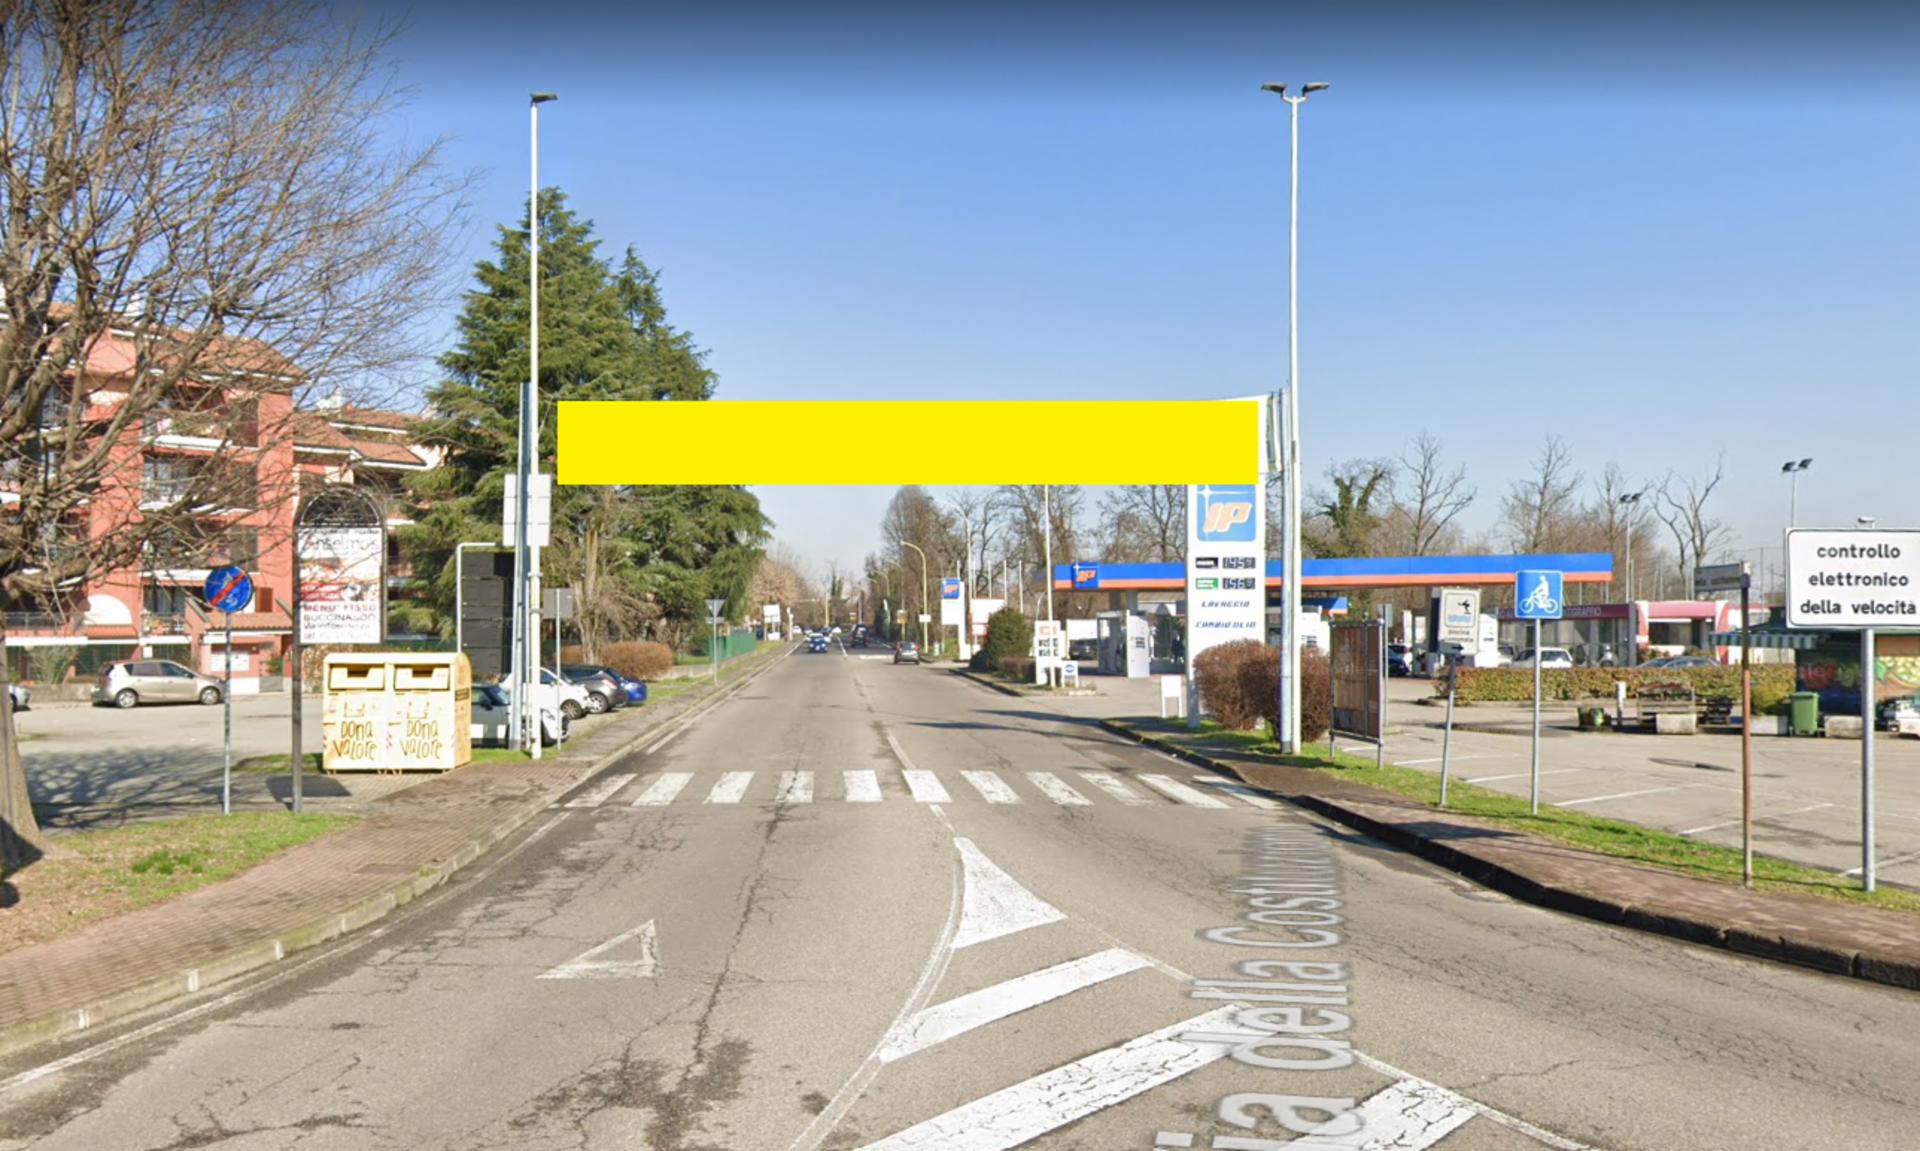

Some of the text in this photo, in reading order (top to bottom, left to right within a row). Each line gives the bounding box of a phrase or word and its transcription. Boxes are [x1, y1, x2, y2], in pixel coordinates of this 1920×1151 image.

[1203, 502, 1252, 532] IP
[1816, 543, 1901, 559] controllo
[1808, 571, 1909, 586] elettronico
[1201, 600, 1250, 608] LAVAGGIO
[1800, 599, 1917, 614] della velocità
